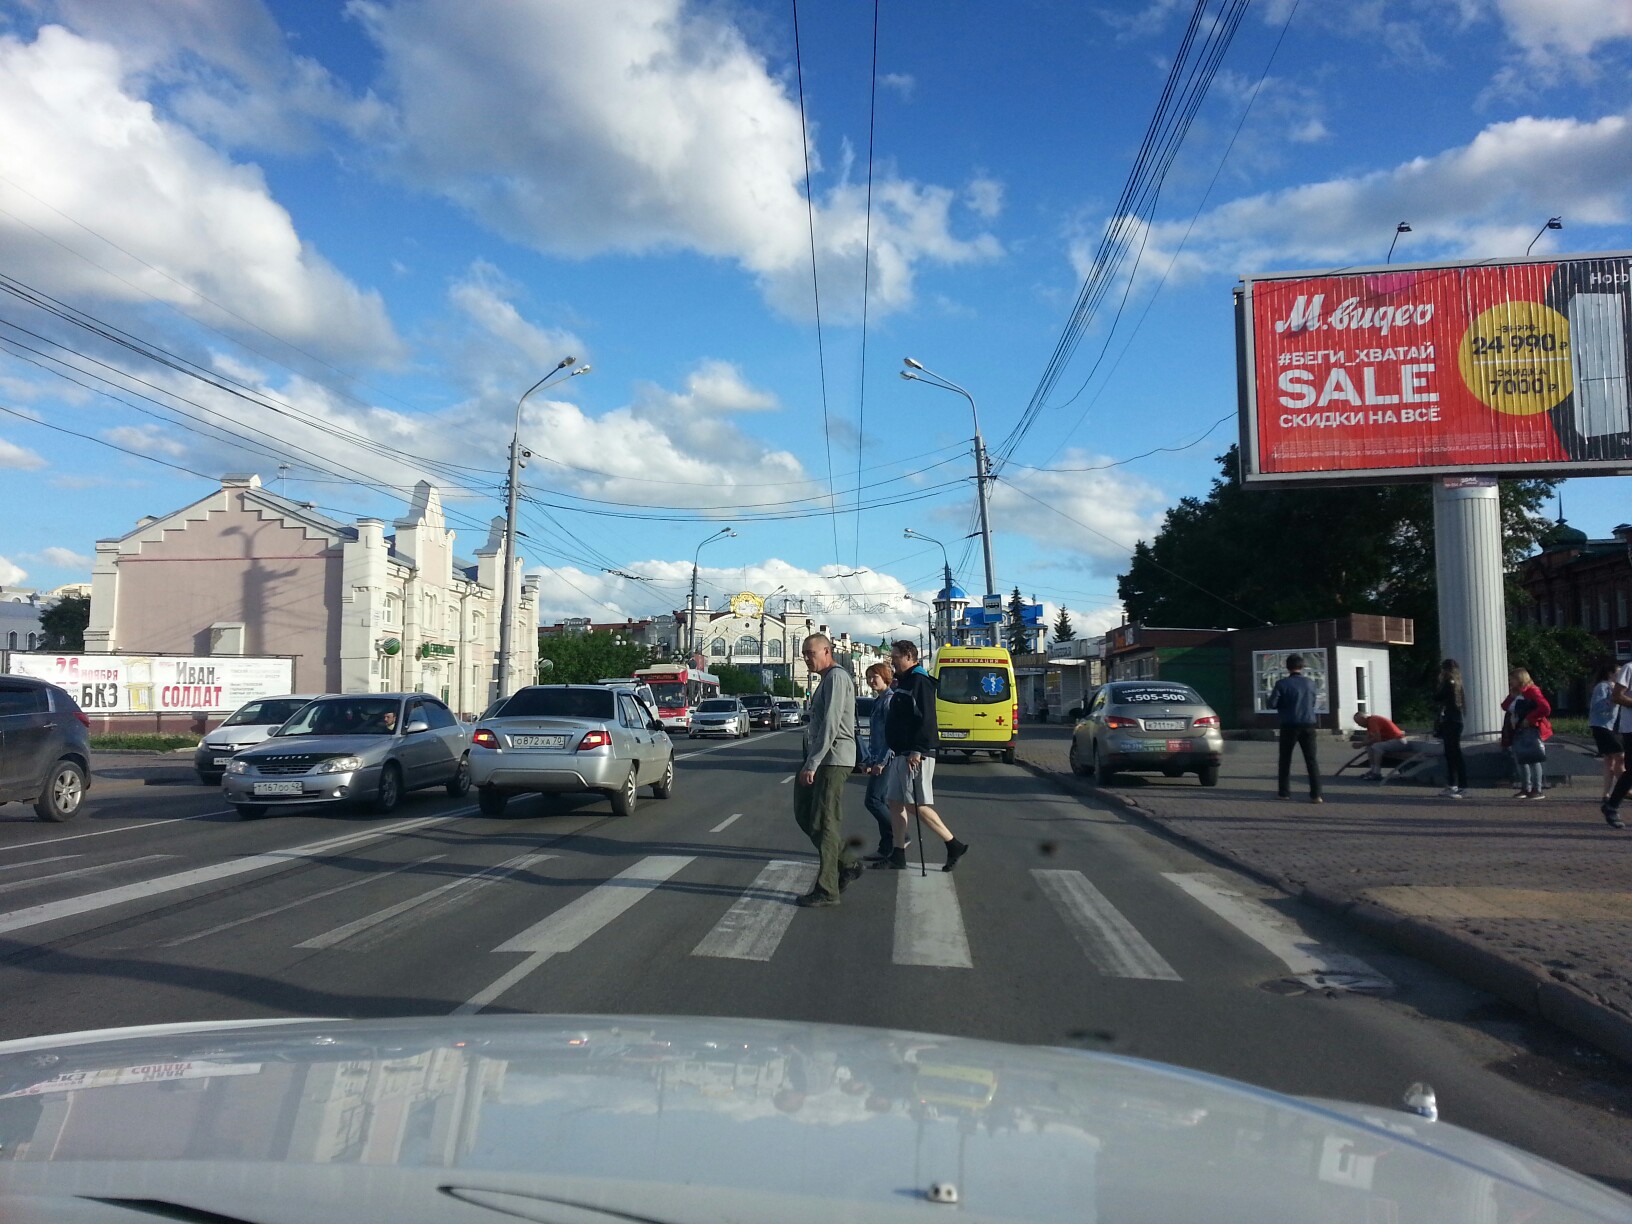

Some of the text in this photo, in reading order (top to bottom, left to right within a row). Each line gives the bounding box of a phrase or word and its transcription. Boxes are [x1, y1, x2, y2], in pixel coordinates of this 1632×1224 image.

[1275, 294, 1434, 336] М.видео
[1278, 341, 1435, 366] #БЕГИ_ХВАТАЙ
[1473, 336, 1504, 355] 24
[1511, 333, 1556, 353] 990
[1497, 367, 1547, 378] СКИДКА
[1278, 363, 1439, 409] SALE
[1490, 378, 1544, 396] 7000
[1279, 405, 1441, 429] СКИДКИ НА ВСЁ
[81, 682, 118, 708] БКЗ
[161, 685, 222, 708] СОЛДАТ
